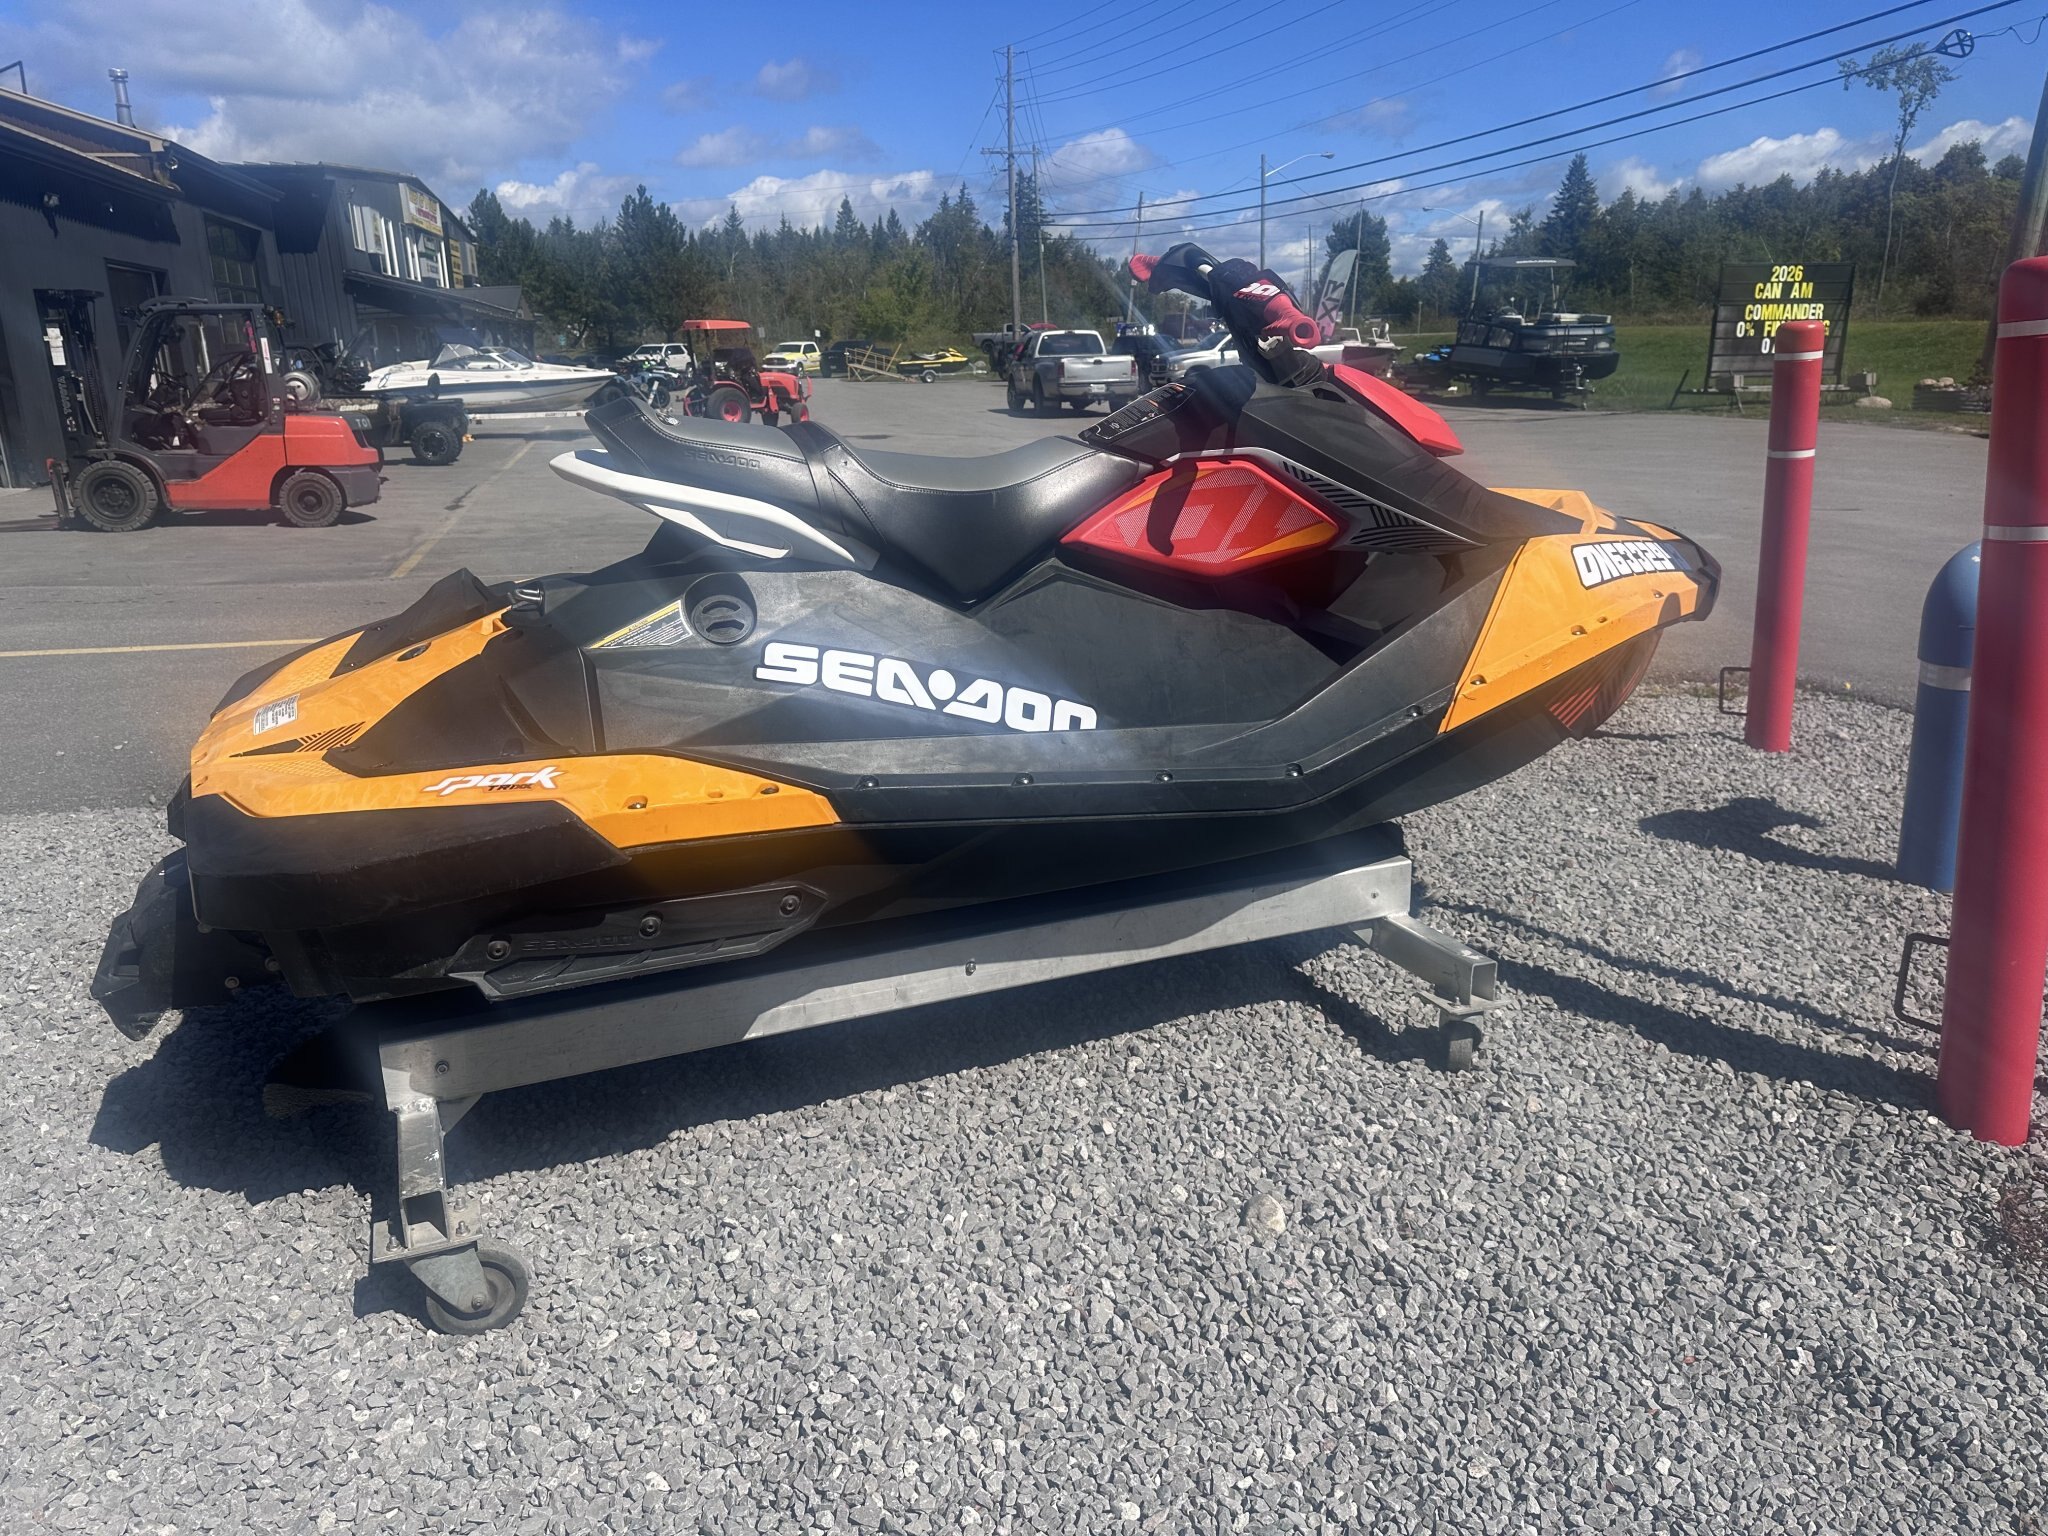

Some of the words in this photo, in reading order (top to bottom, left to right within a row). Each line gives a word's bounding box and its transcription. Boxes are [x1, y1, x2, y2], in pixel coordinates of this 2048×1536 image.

[1770, 265, 1804, 282] 2026
[1754, 282, 1782, 299] CAN
[1790, 282, 1814, 299] AM
[1744, 303, 1824, 321] COMMANDER
[1736, 321, 1755, 338] 0%
